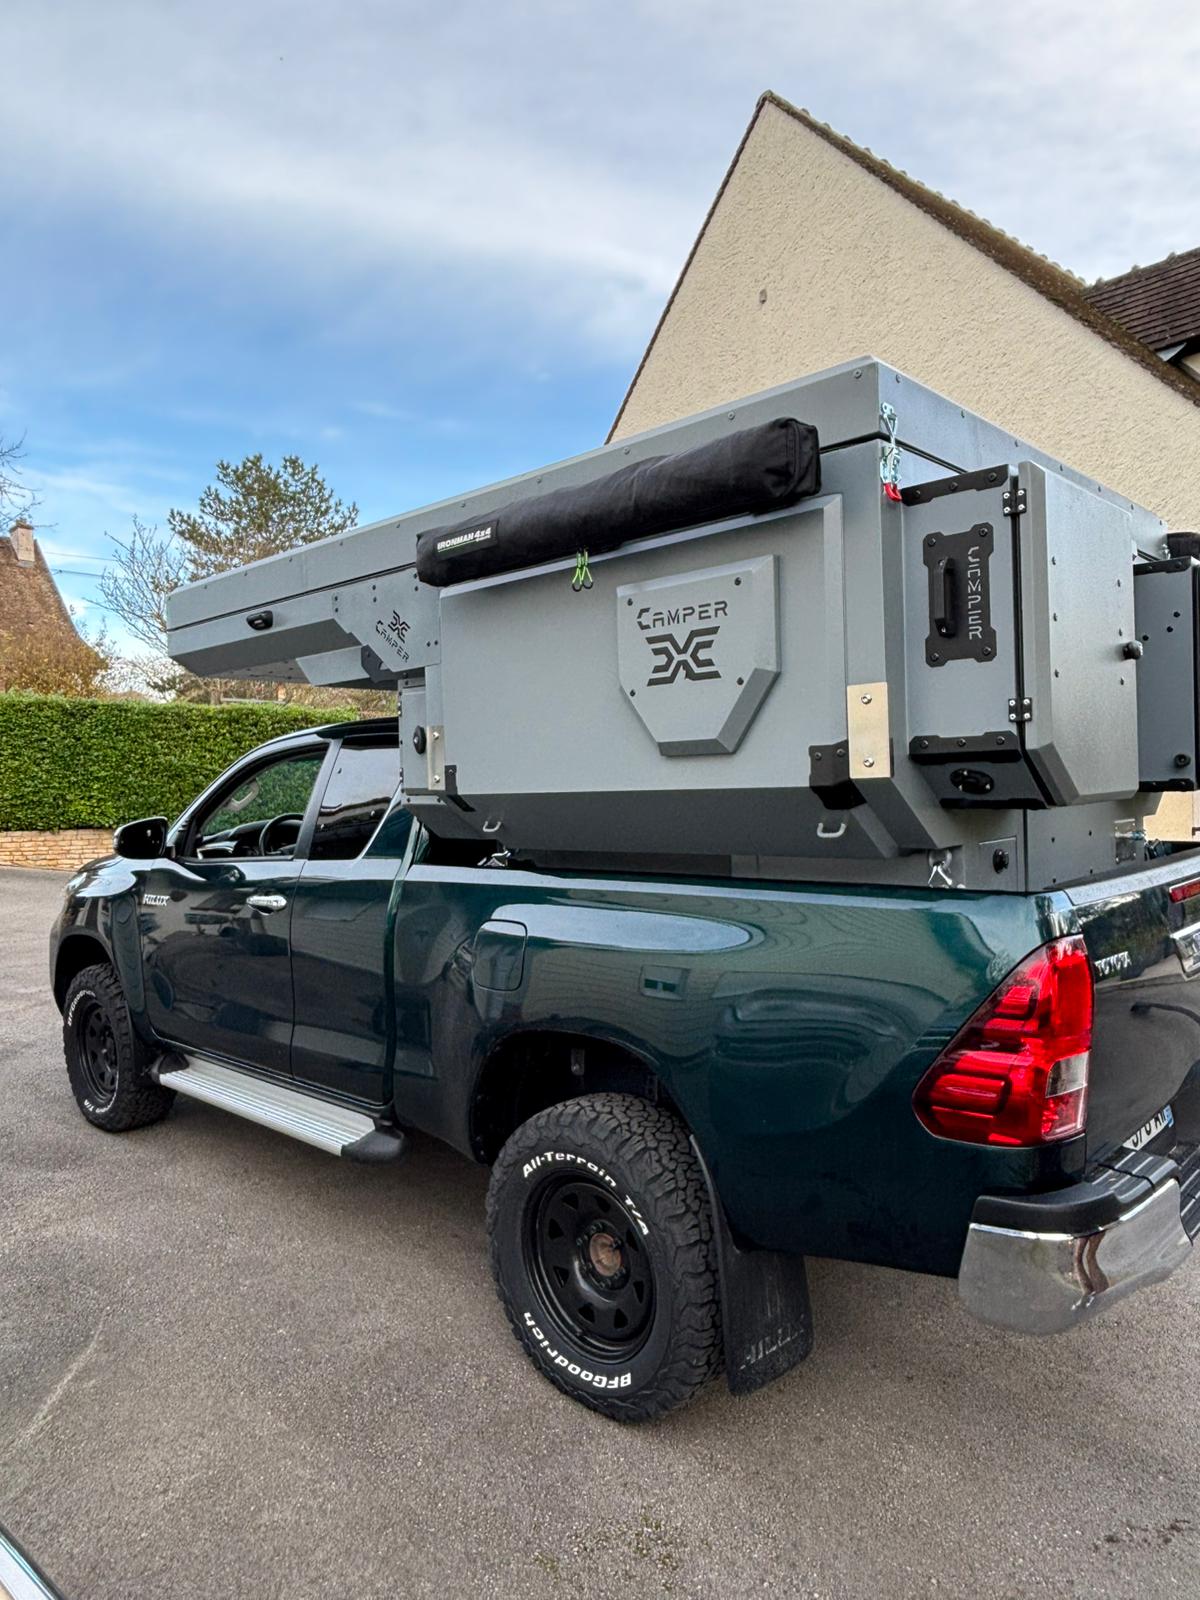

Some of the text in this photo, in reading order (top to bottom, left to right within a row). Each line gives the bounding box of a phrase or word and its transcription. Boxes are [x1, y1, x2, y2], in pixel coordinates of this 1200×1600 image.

[437, 532, 475, 550] IRONMAN
[474, 527, 492, 539] 4x4
[636, 600, 728, 630] CAMPER
[968, 546, 983, 640] CAMPER
[375, 619, 410, 663] CAMPER
[522, 1151, 649, 1235] All-Terrain T/A
[523, 1312, 632, 1389] BFGoodrich
